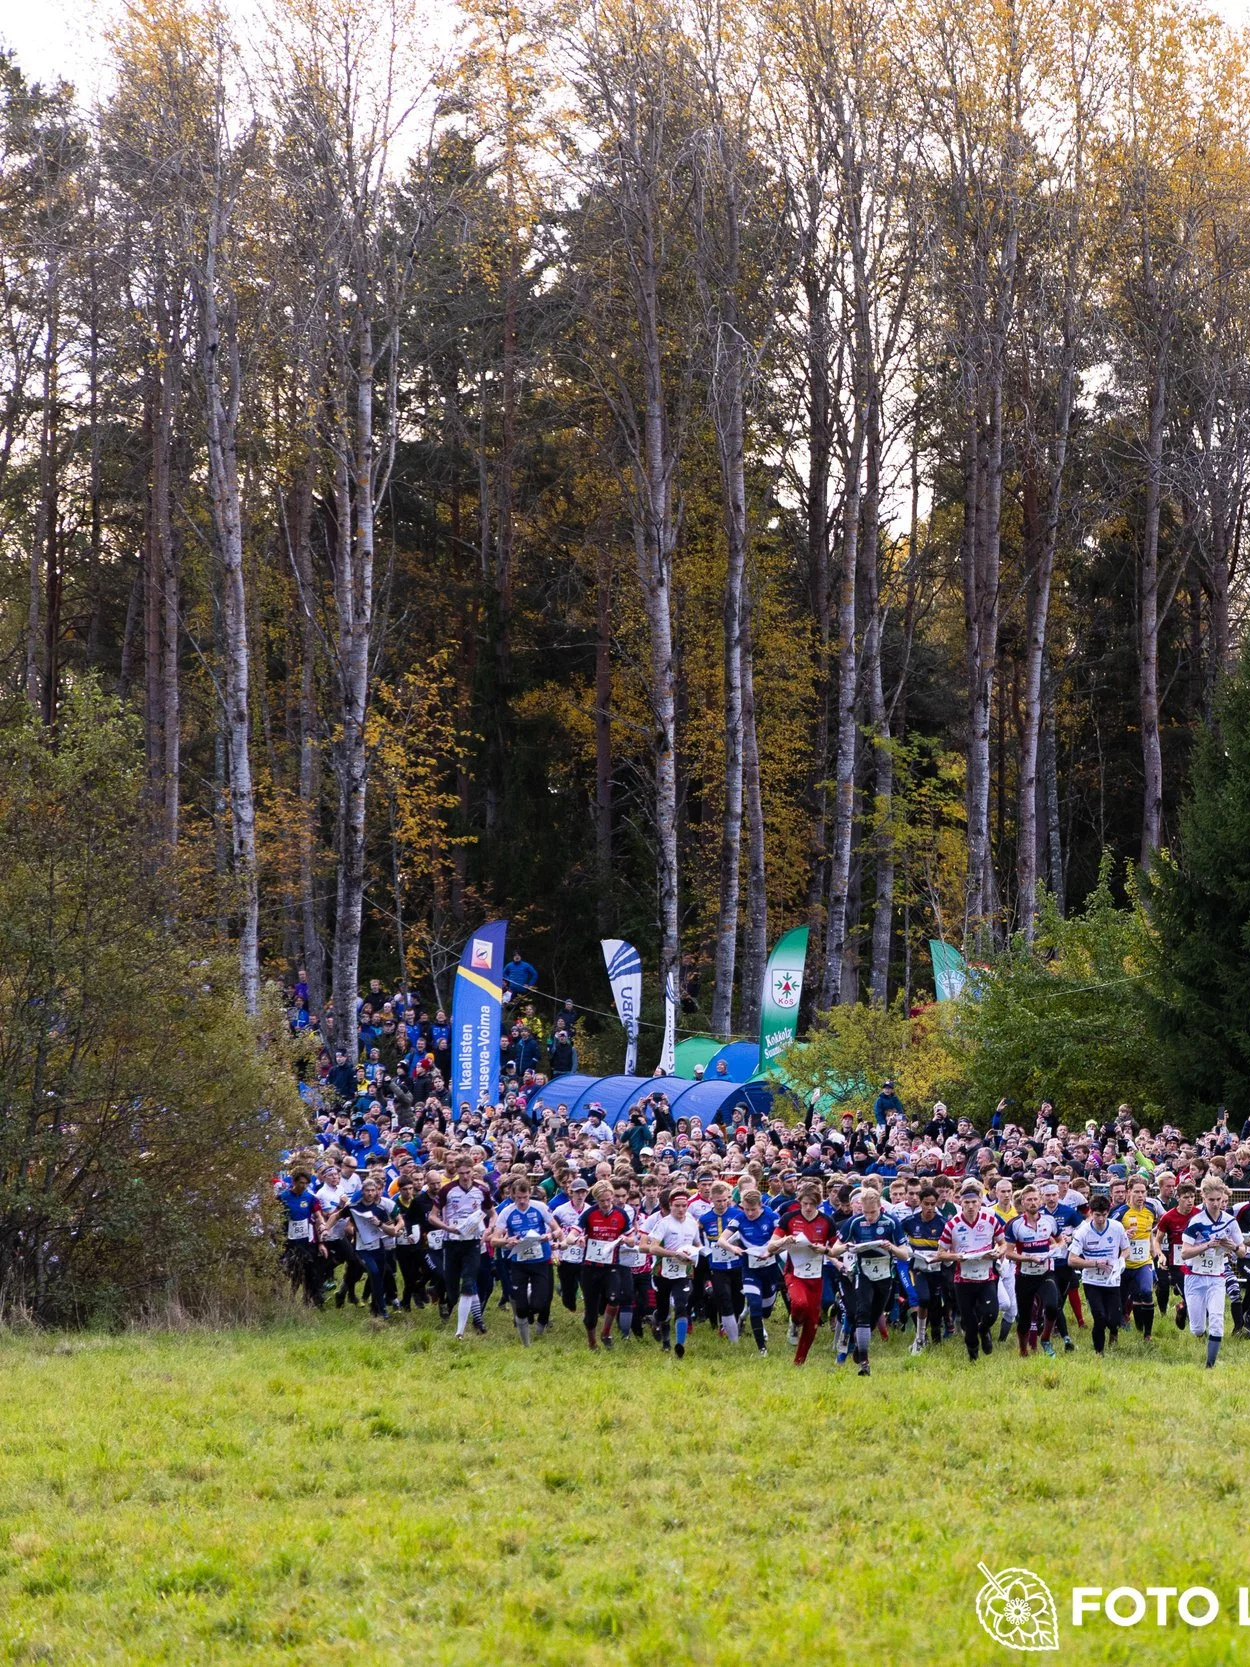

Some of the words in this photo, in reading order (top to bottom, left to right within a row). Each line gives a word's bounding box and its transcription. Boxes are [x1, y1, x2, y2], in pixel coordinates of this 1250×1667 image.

[459, 1024, 473, 1091] Ikaalisten
[294, 1226, 304, 1234] 83
[570, 1247, 581, 1256] 63
[1132, 1246, 1144, 1255] 18
[668, 1264, 679, 1273] 23
[804, 1263, 812, 1272] 2
[1201, 1259, 1214, 1269] 19
[872, 1265, 879, 1274] 4
